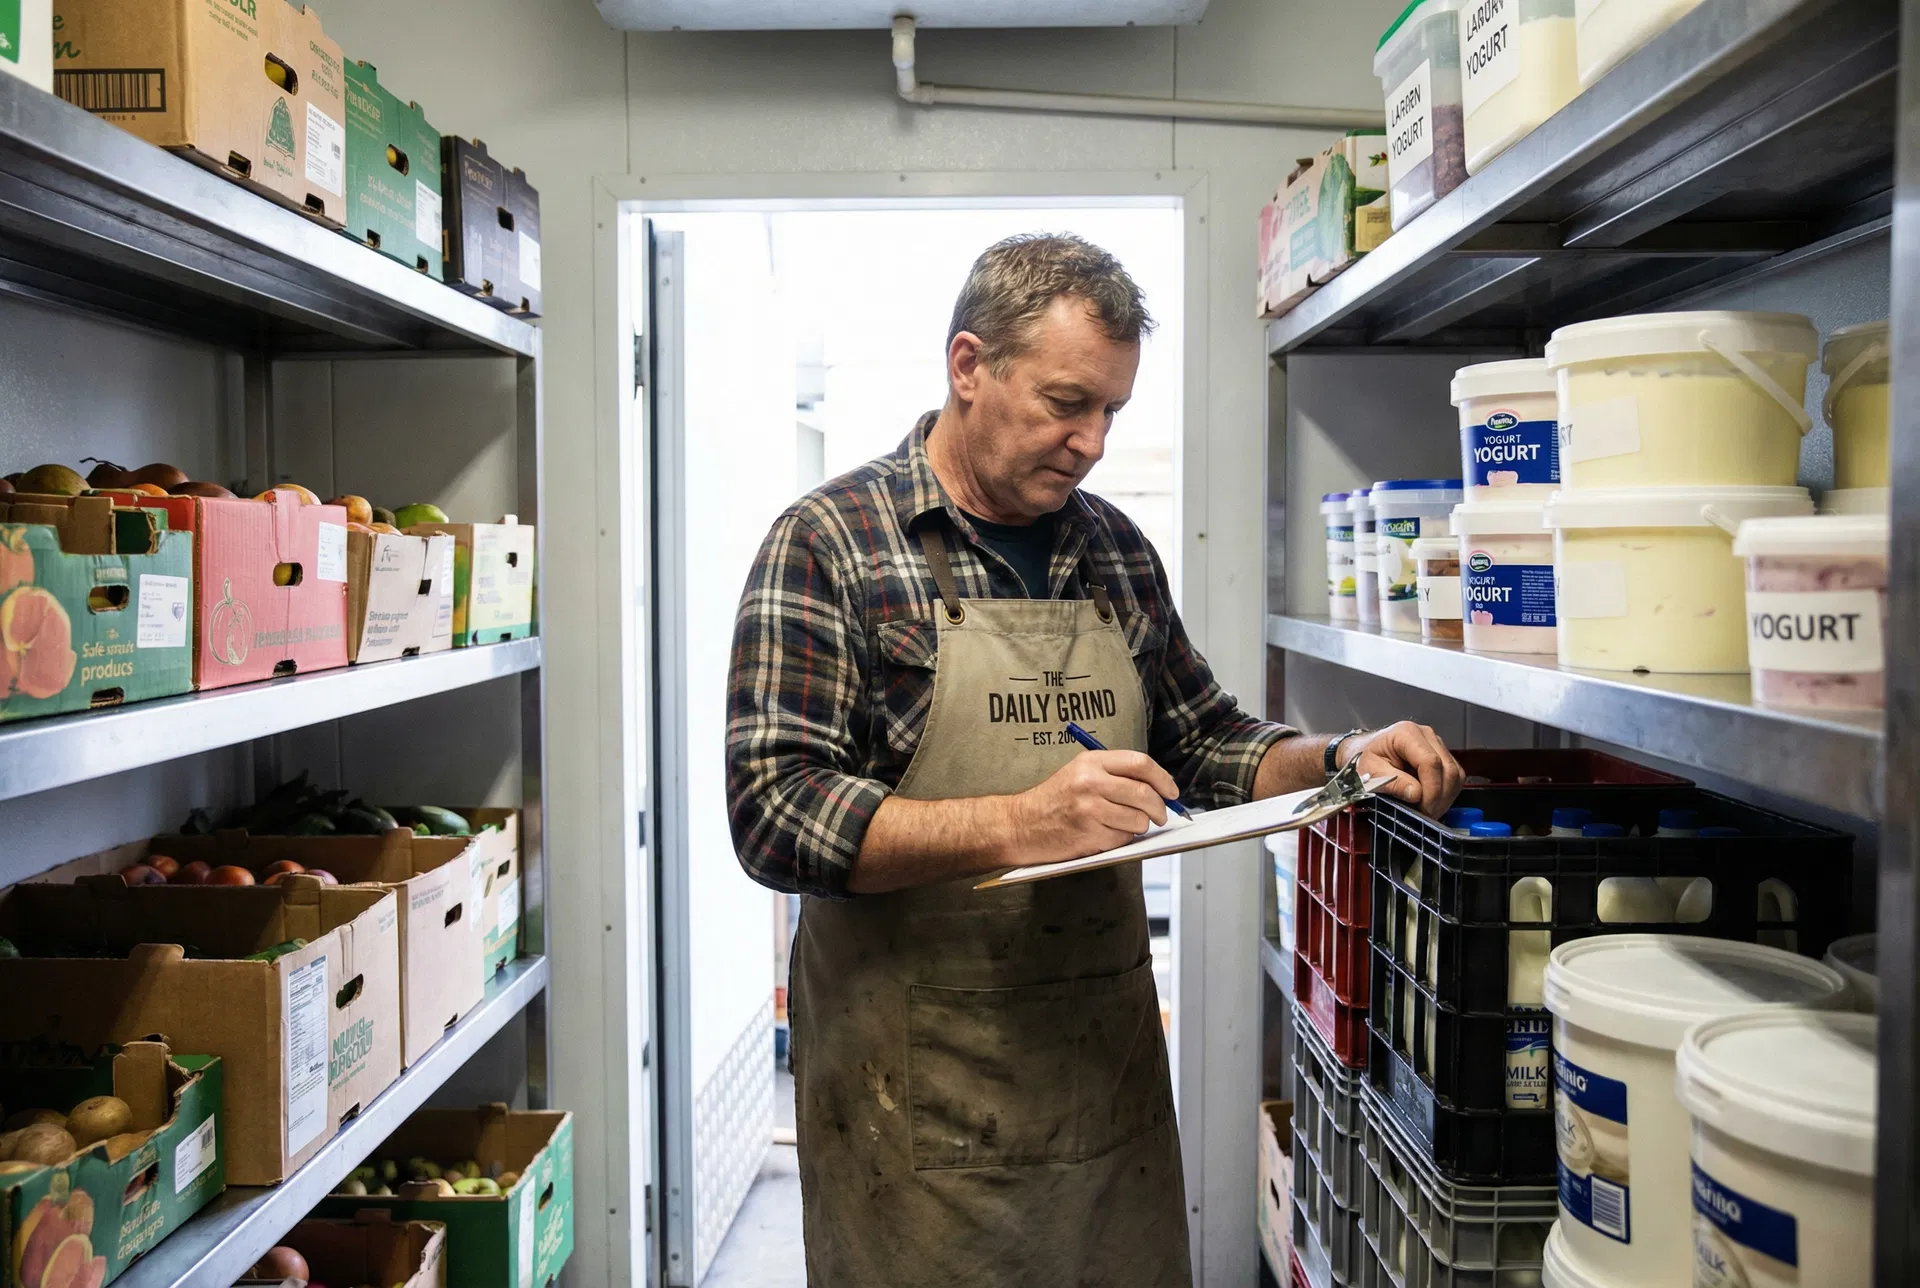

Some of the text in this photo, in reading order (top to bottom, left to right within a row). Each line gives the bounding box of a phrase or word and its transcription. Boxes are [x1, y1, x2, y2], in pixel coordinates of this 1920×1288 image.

[1467, 23, 1508, 80] YOGURT
[1392, 116, 1424, 160] YOGURT
[1484, 433, 1522, 445] YOGURT
[1473, 444, 1541, 464] YOGURT
[1752, 612, 1861, 641] YOGURT
[1042, 671, 1064, 687] THE
[988, 688, 1116, 723] DAILY GRIND
[1032, 731, 1056, 745] EST.
[1506, 1066, 1547, 1080] MILK
